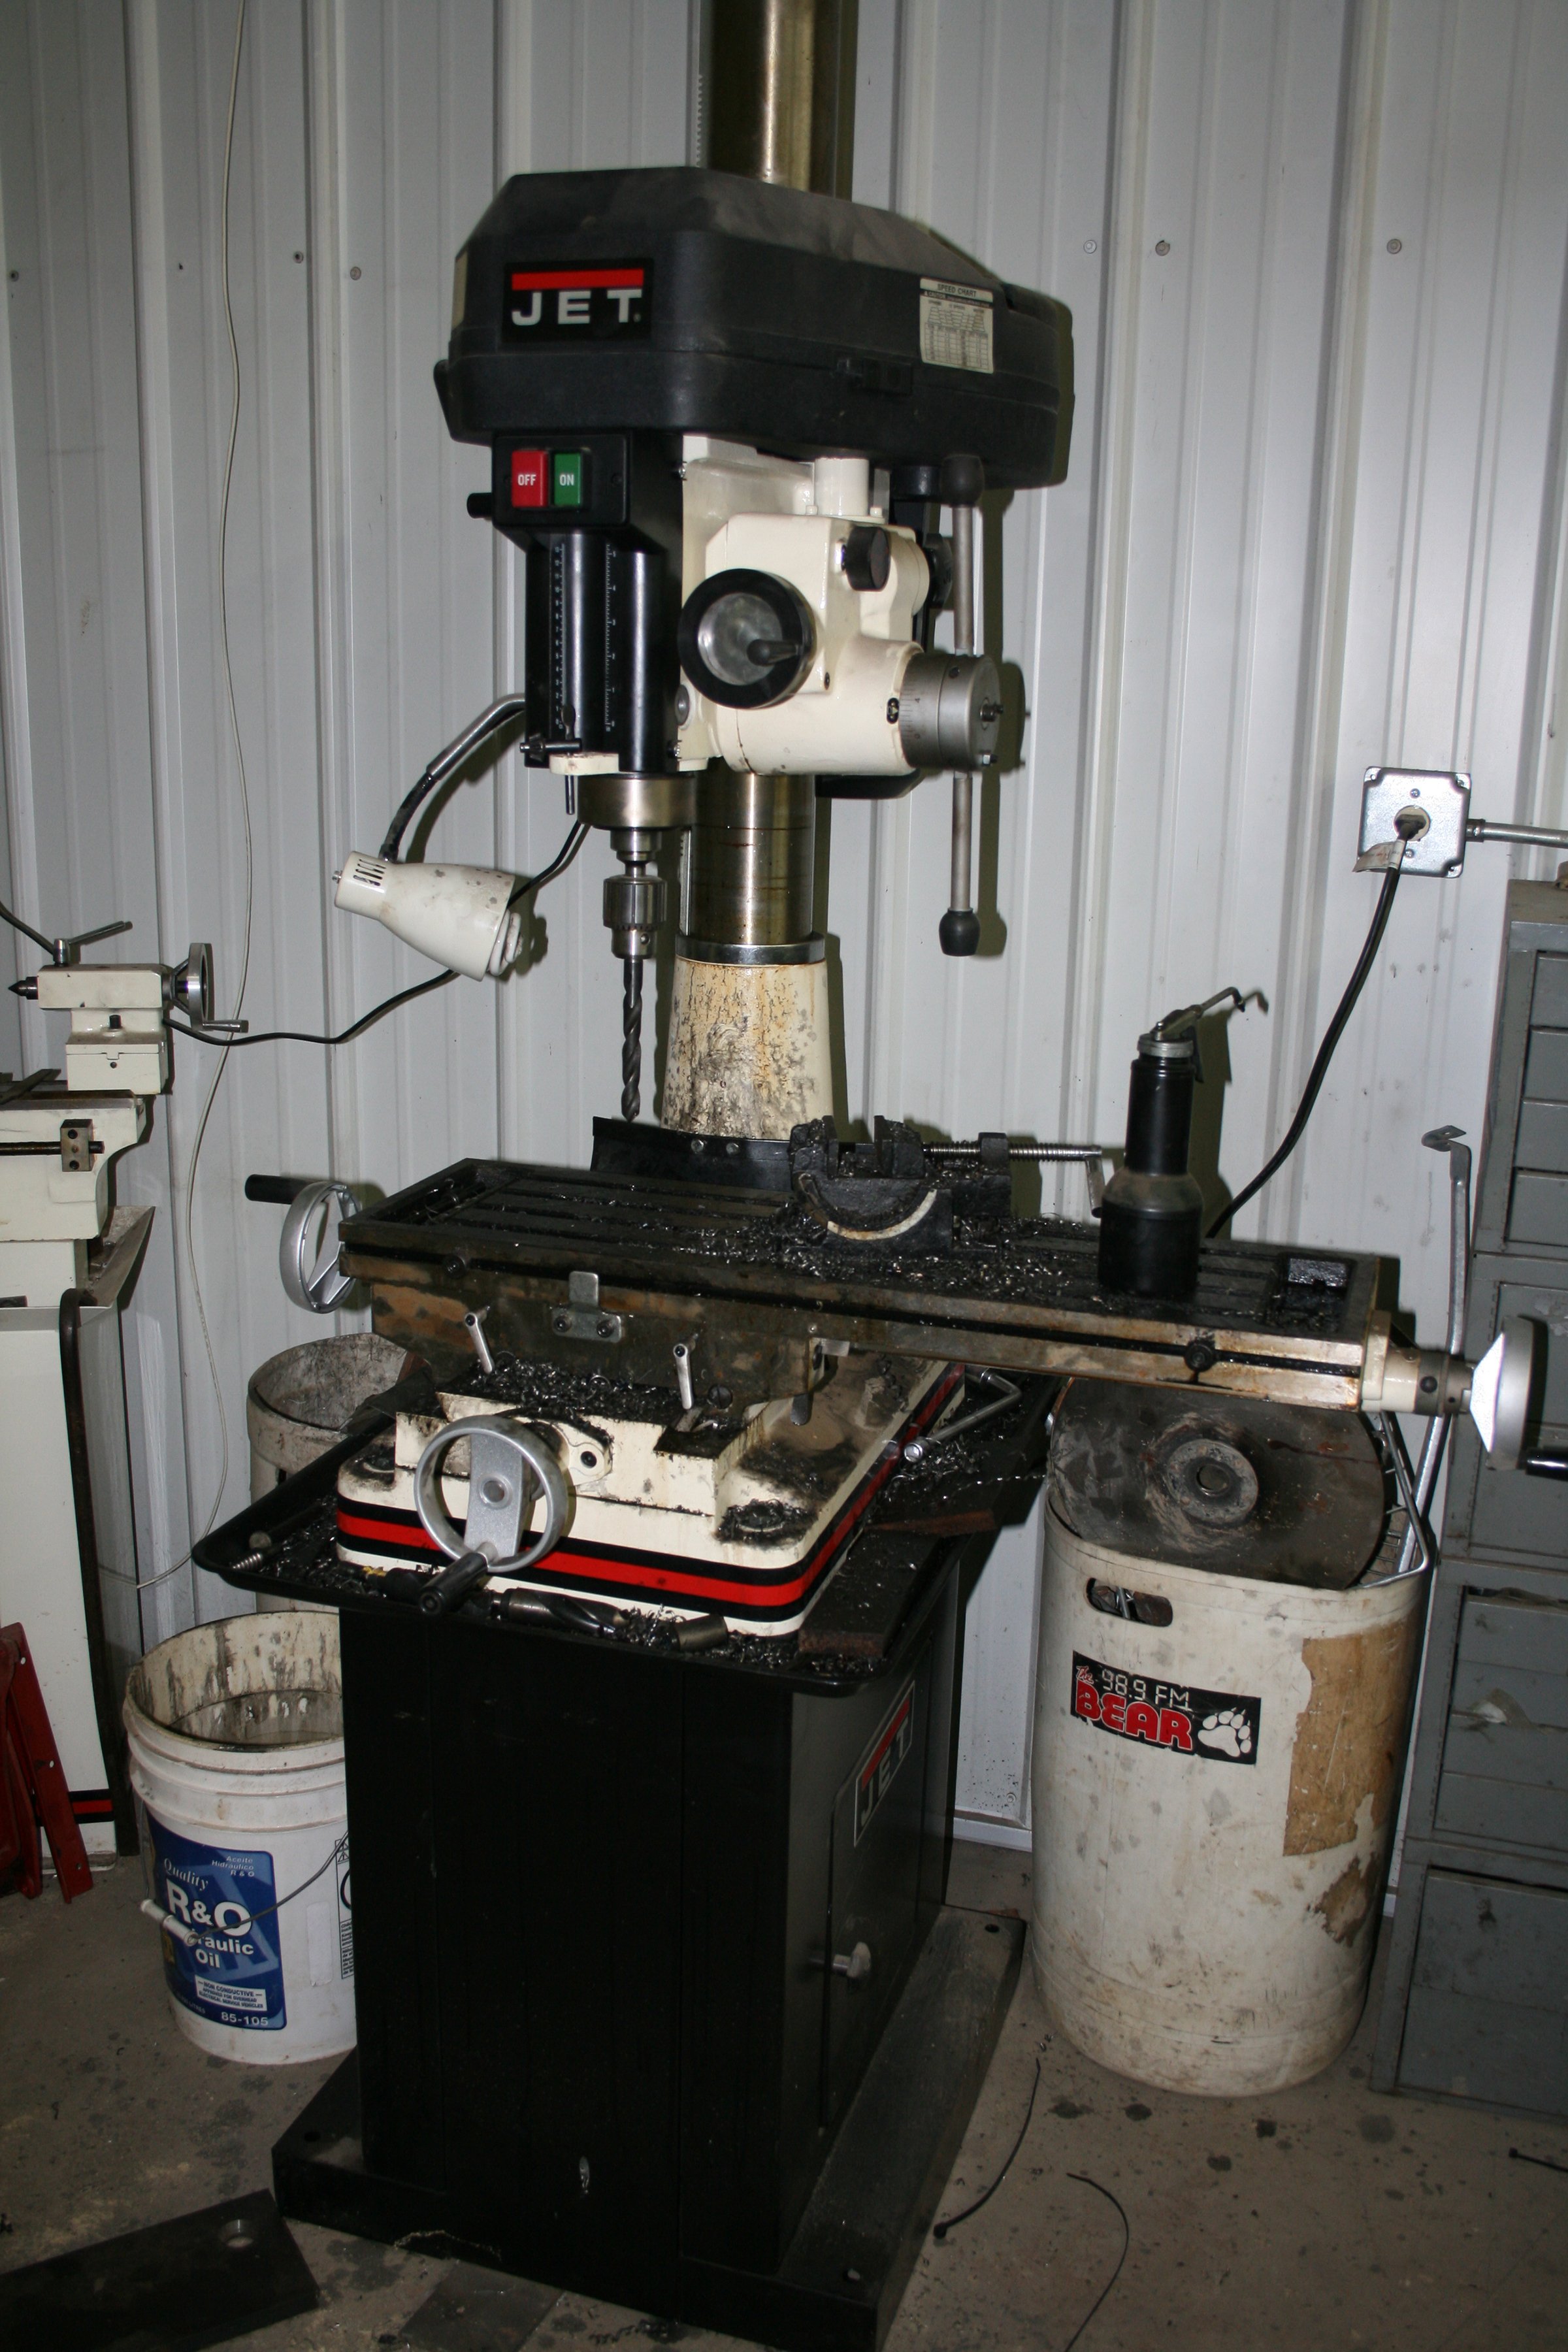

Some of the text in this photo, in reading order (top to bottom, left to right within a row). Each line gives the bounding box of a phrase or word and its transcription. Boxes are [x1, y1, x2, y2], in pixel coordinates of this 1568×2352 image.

[938, 284, 977, 297] SPEED CHART
[512, 289, 642, 326] JET
[518, 474, 536, 486] OFF
[560, 474, 574, 486] ON
[1076, 1666, 1094, 1685] The
[1102, 1669, 1189, 1709] 98.9 FM
[1075, 1679, 1193, 1751] BEAR
[861, 1716, 909, 1827] JET
[164, 1858, 208, 1891] Quality
[166, 1878, 252, 1936] R&O
[195, 1949, 220, 1968] Oil
[204, 1981, 254, 1997] NON CONDUCTIVE
[221, 2012, 269, 2026] 85-105
